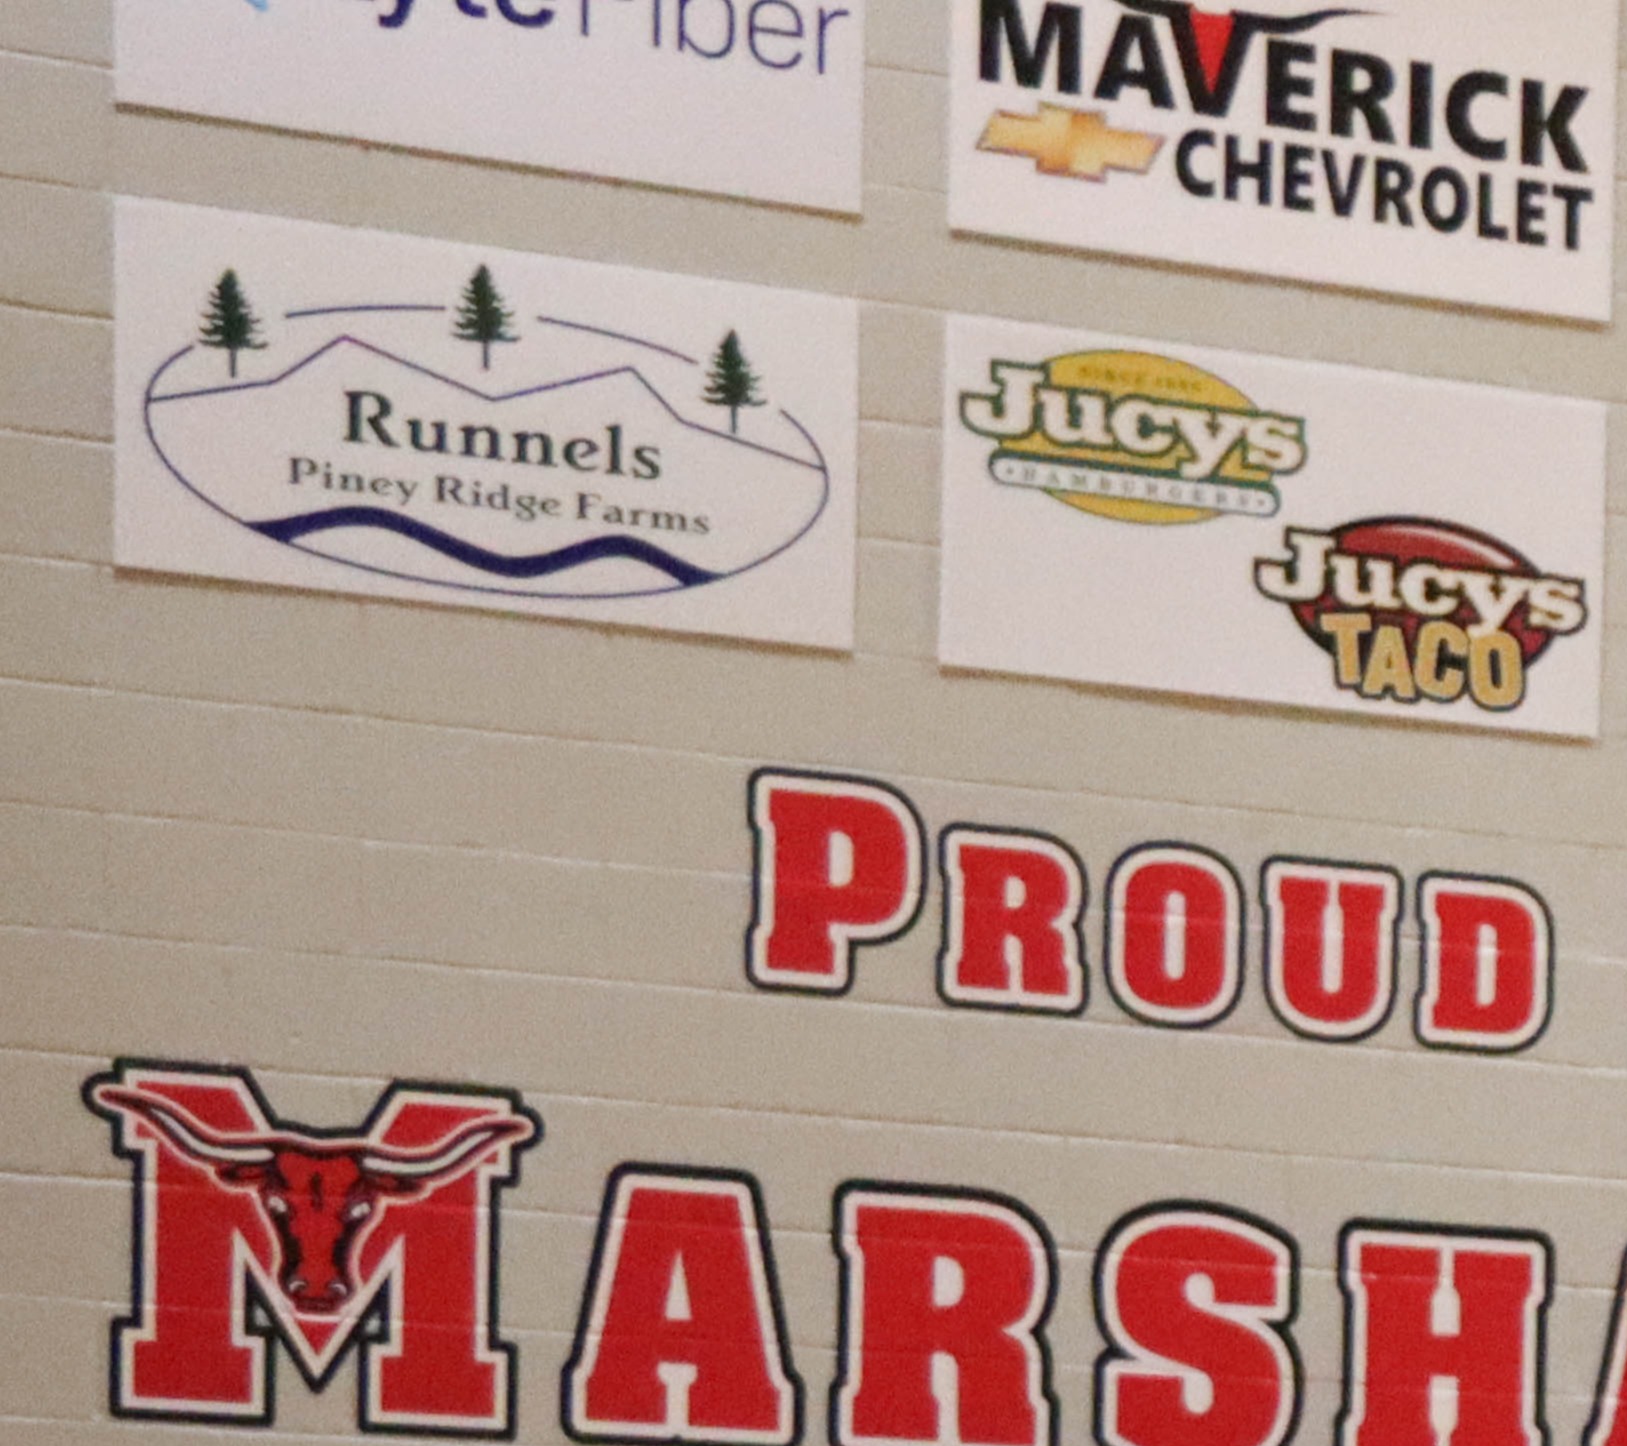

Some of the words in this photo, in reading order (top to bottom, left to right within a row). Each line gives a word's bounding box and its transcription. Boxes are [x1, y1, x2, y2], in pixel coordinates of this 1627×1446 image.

[978, 0, 1591, 174] MAVERICK
[1175, 130, 1594, 250] CHEVROLET
[344, 390, 661, 480] Runnels
[960, 359, 1306, 481] Jucys
[288, 457, 418, 507] Piney
[436, 475, 561, 521] Ridge
[576, 492, 710, 534] Farms
[1254, 525, 1588, 638] Jucys
[1320, 612, 1526, 711] TACO
[748, 768, 1553, 1053] PROUD
